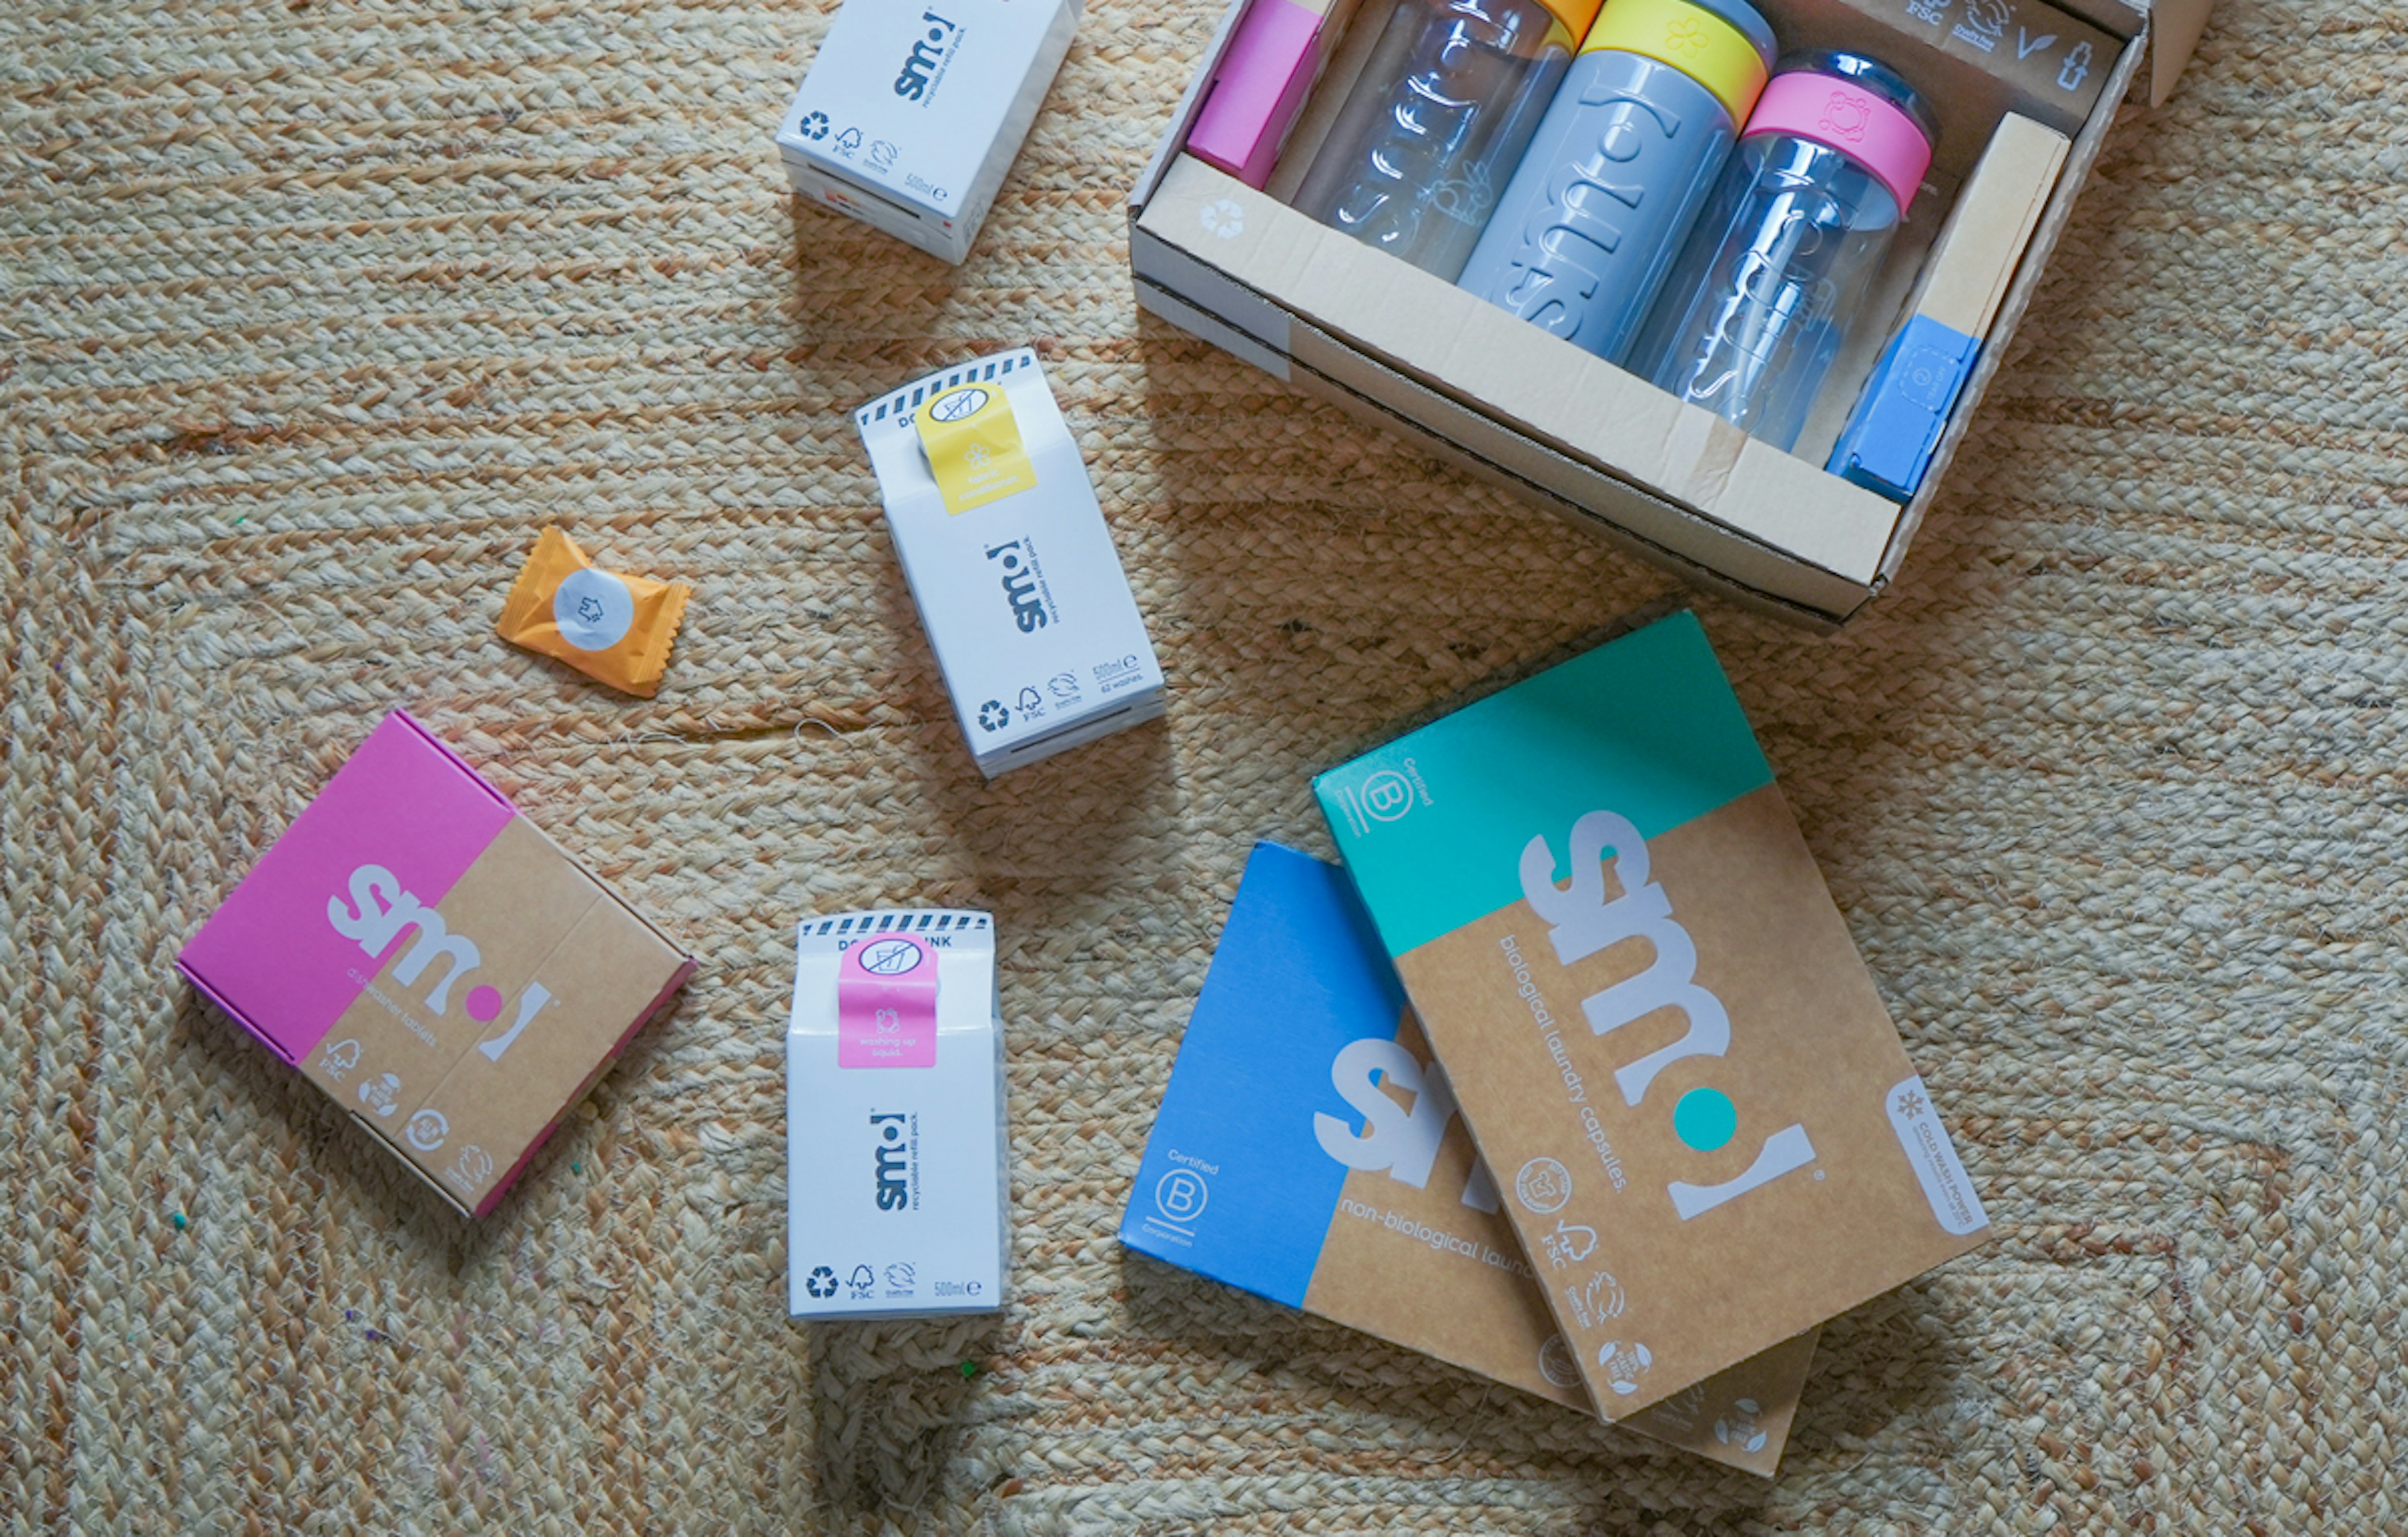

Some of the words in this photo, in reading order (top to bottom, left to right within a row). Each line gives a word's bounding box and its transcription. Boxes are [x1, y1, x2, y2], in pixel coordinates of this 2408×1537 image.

[1906, 3, 1943, 26] FSC
[894, 12, 955, 100] smol
[1491, 83, 1682, 341] smol
[985, 540, 1047, 633] smol
[1023, 707, 1045, 722] FSC
[1370, 780, 1403, 811] B
[1403, 757, 1434, 807] Certified
[1334, 790, 1361, 839] Corporation
[327, 864, 552, 1062] smol
[346, 967, 402, 1016] dishwasher
[1518, 810, 1817, 1222] smol
[860, 1037, 900, 1047] washing
[903, 1038, 916, 1047] up
[1500, 934, 1555, 1030] biological
[1545, 1029, 1588, 1104] laundry
[1580, 1106, 1627, 1193] capsules.
[319, 1058, 346, 1083] FSC
[870, 1114, 907, 1210] smol
[910, 1138, 919, 1157] refill
[1168, 1149, 1219, 1176] Certified
[911, 1158, 921, 1210] recyclable
[1166, 1177, 1196, 1212] B
[1919, 1121, 1938, 1153] COLD
[1934, 1151, 1954, 1186] WASH
[1949, 1183, 1973, 1224] POWER
[1141, 1223, 1193, 1247] Corporation
[1340, 1198, 1480, 1259] non-biological
[1541, 1234, 1566, 1270] FSC
[850, 1291, 875, 1299] FSC
